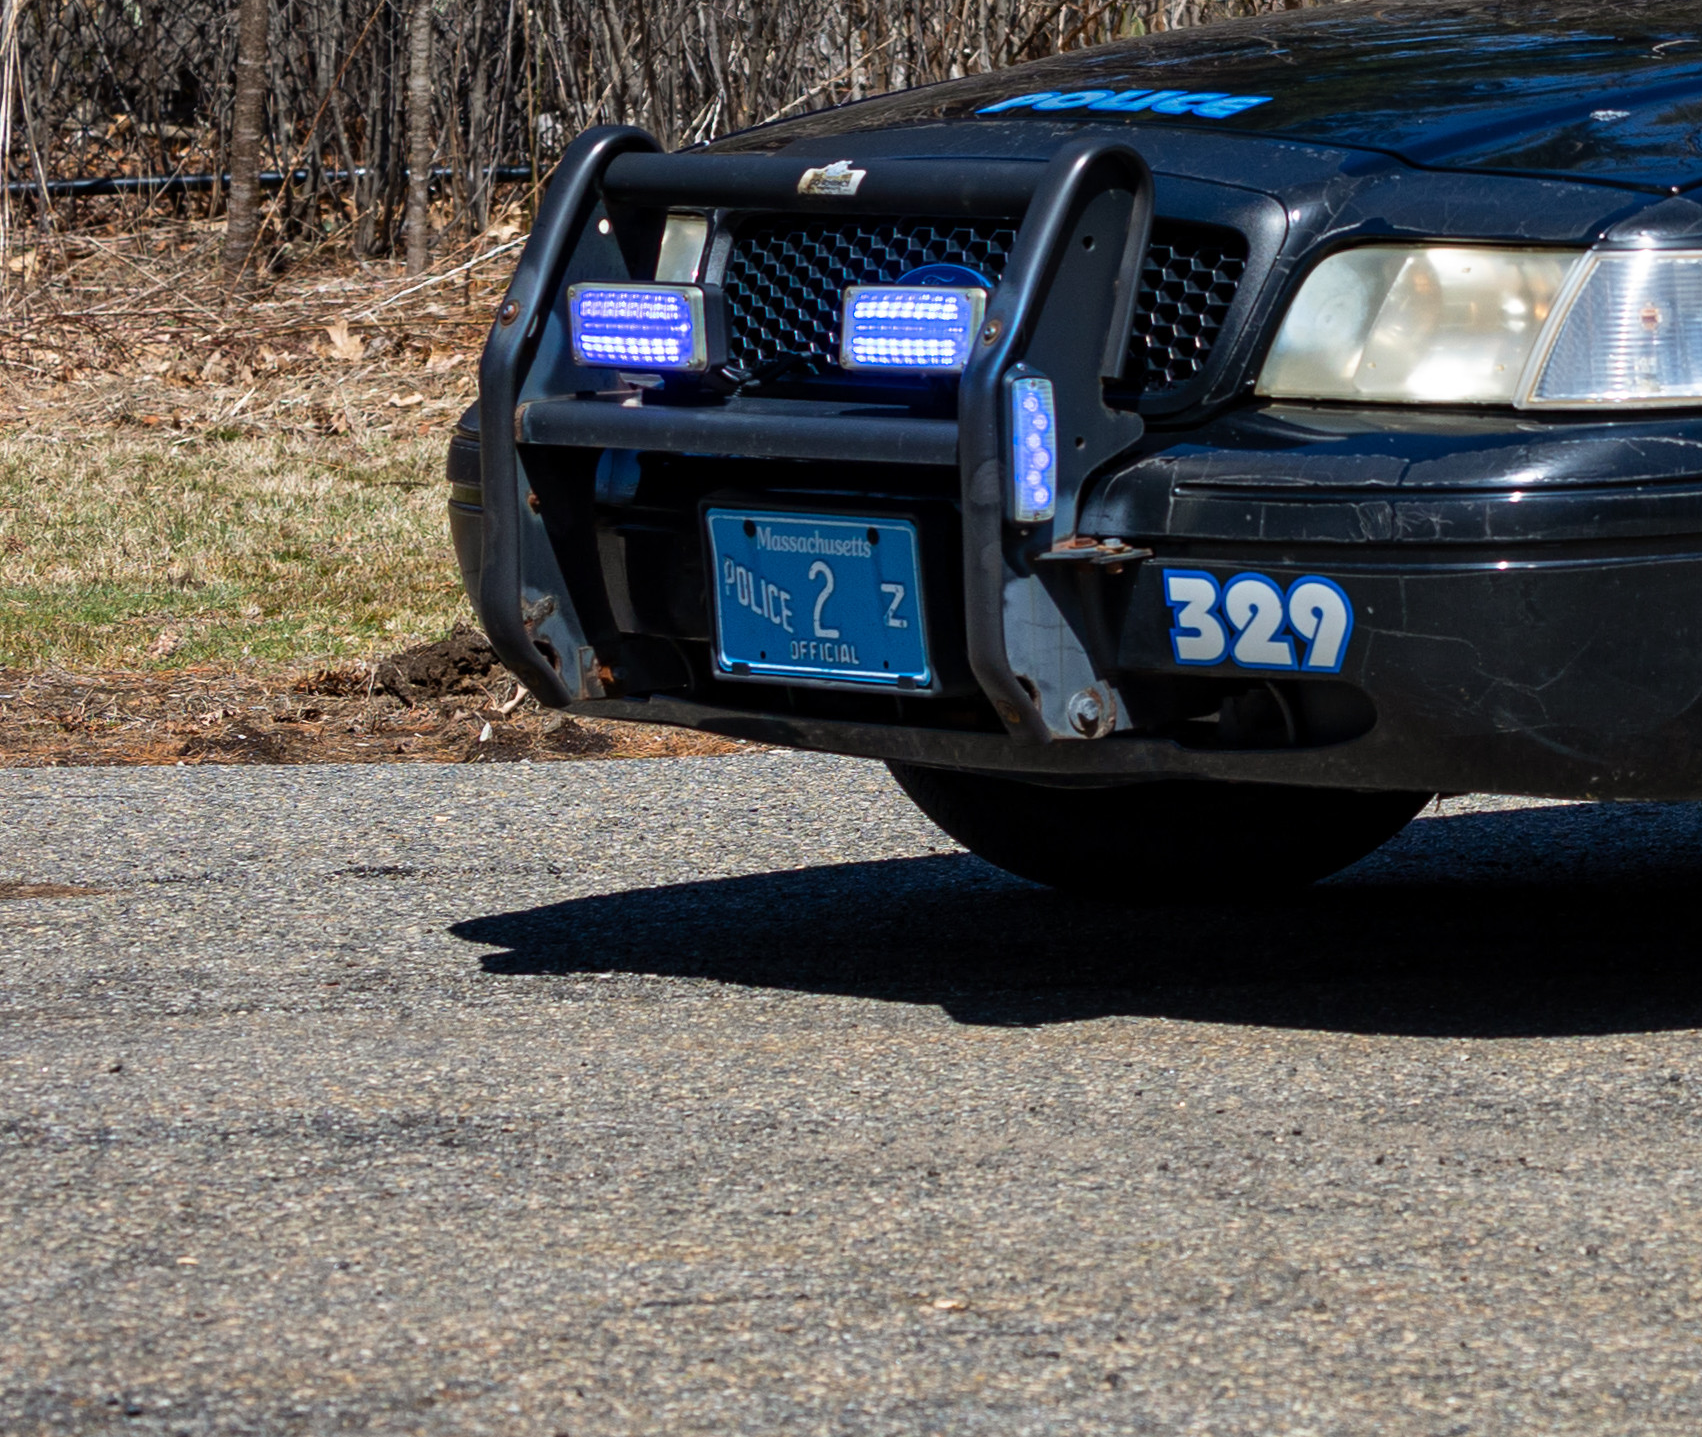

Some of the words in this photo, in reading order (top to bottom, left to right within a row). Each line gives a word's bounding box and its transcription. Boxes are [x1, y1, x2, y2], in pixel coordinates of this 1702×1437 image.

[974, 89, 1275, 119] POLICE
[756, 526, 872, 558] Massachusetts
[723, 555, 795, 634] POLICE
[808, 560, 841, 639] 2
[1163, 568, 1355, 674] 329
[790, 639, 860, 665] OFFICIAL
